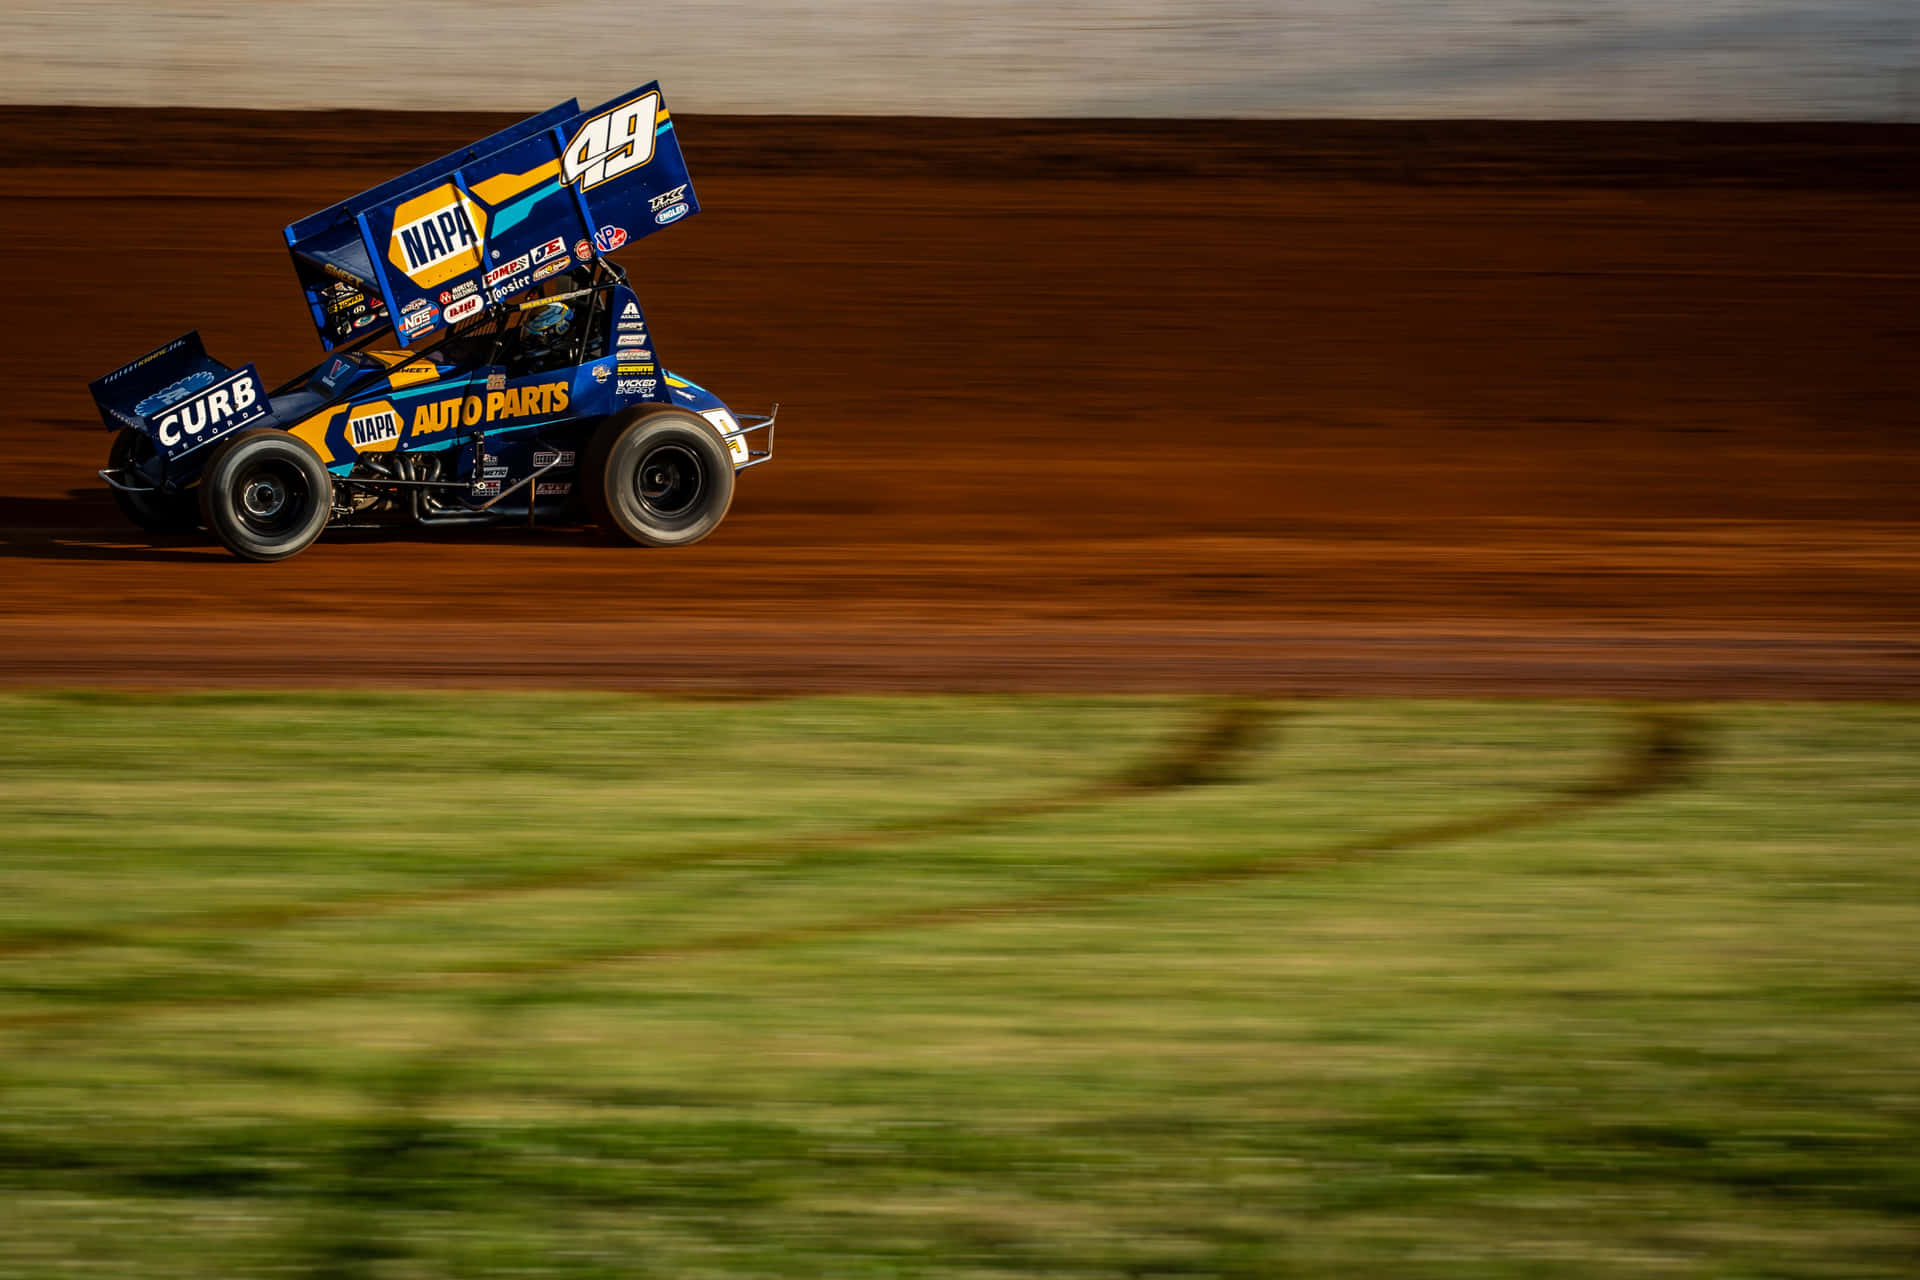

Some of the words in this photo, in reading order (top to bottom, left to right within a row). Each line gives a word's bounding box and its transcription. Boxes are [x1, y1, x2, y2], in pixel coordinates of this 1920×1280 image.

[562, 91, 659, 190] 49
[400, 205, 479, 268] NAPA
[596, 226, 616, 250] VP
[485, 261, 518, 284] COMP
[486, 275, 531, 304] Hoosier
[404, 306, 433, 330] NOS
[617, 379, 657, 387] WICKED
[159, 377, 256, 447] CURB
[411, 393, 483, 437] AUTO
[486, 381, 569, 423] PARTS
[167, 404, 263, 457] RECORDS
[352, 412, 397, 445] NAPA
